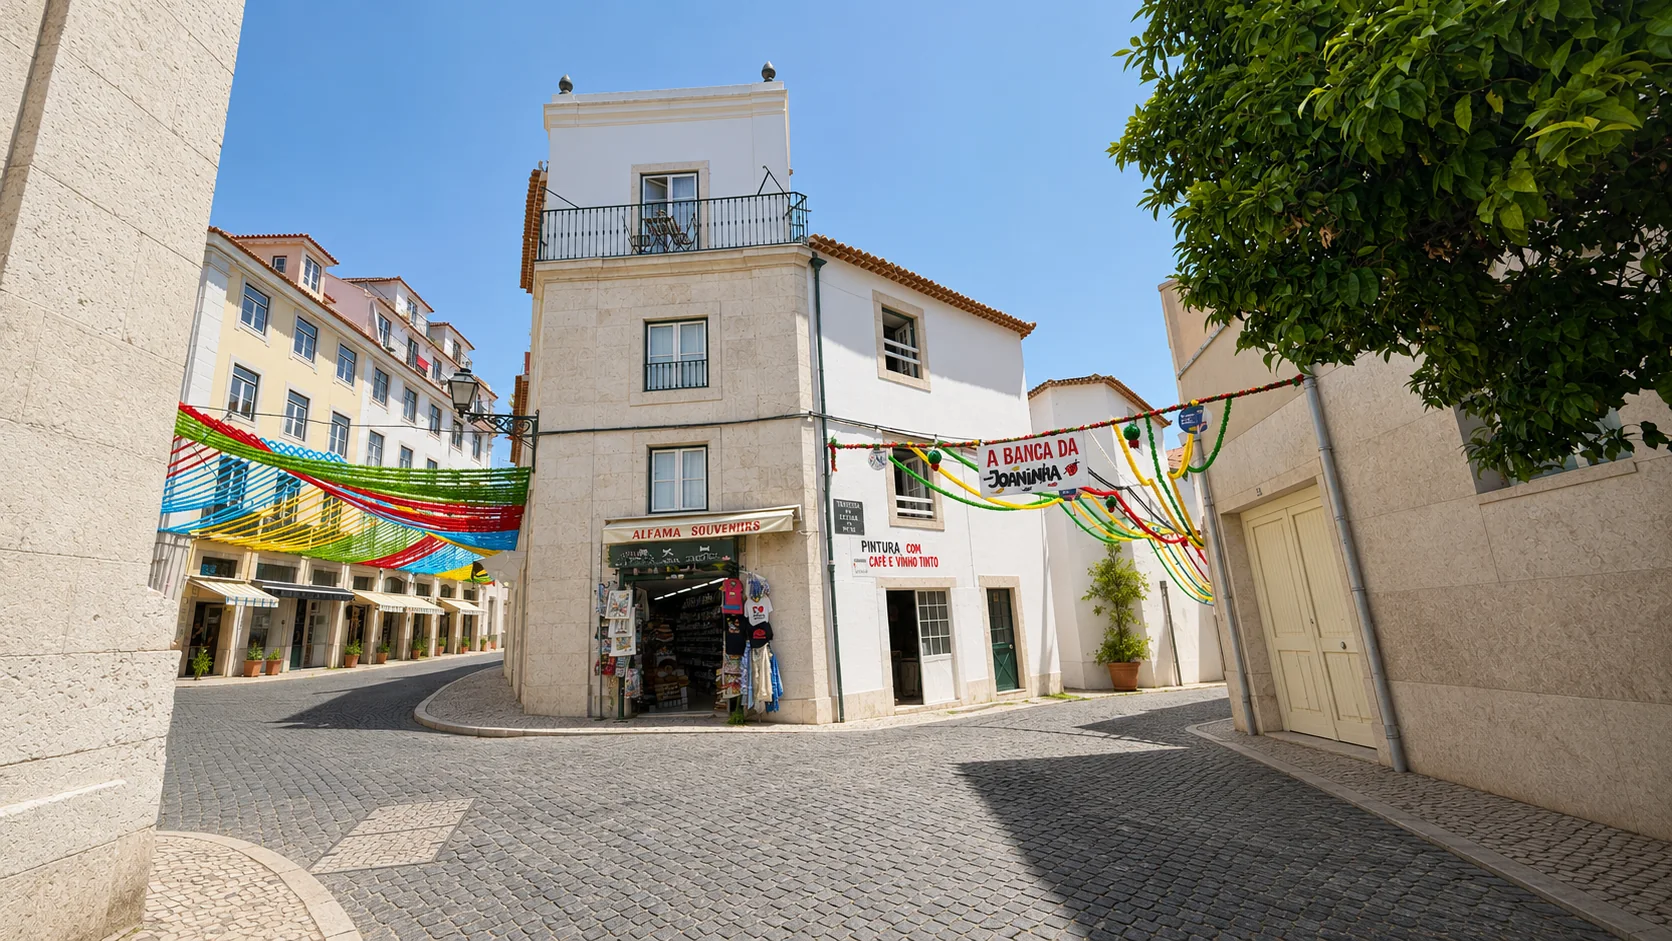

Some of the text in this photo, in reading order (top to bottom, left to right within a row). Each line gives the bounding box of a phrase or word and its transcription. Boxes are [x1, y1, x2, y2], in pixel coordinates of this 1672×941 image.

[987, 437, 1079, 468] A BANCA DA
[632, 527, 681, 540] ALFAMA
[861, 540, 922, 554] PINTURA COM
[888, 556, 894, 567] E
